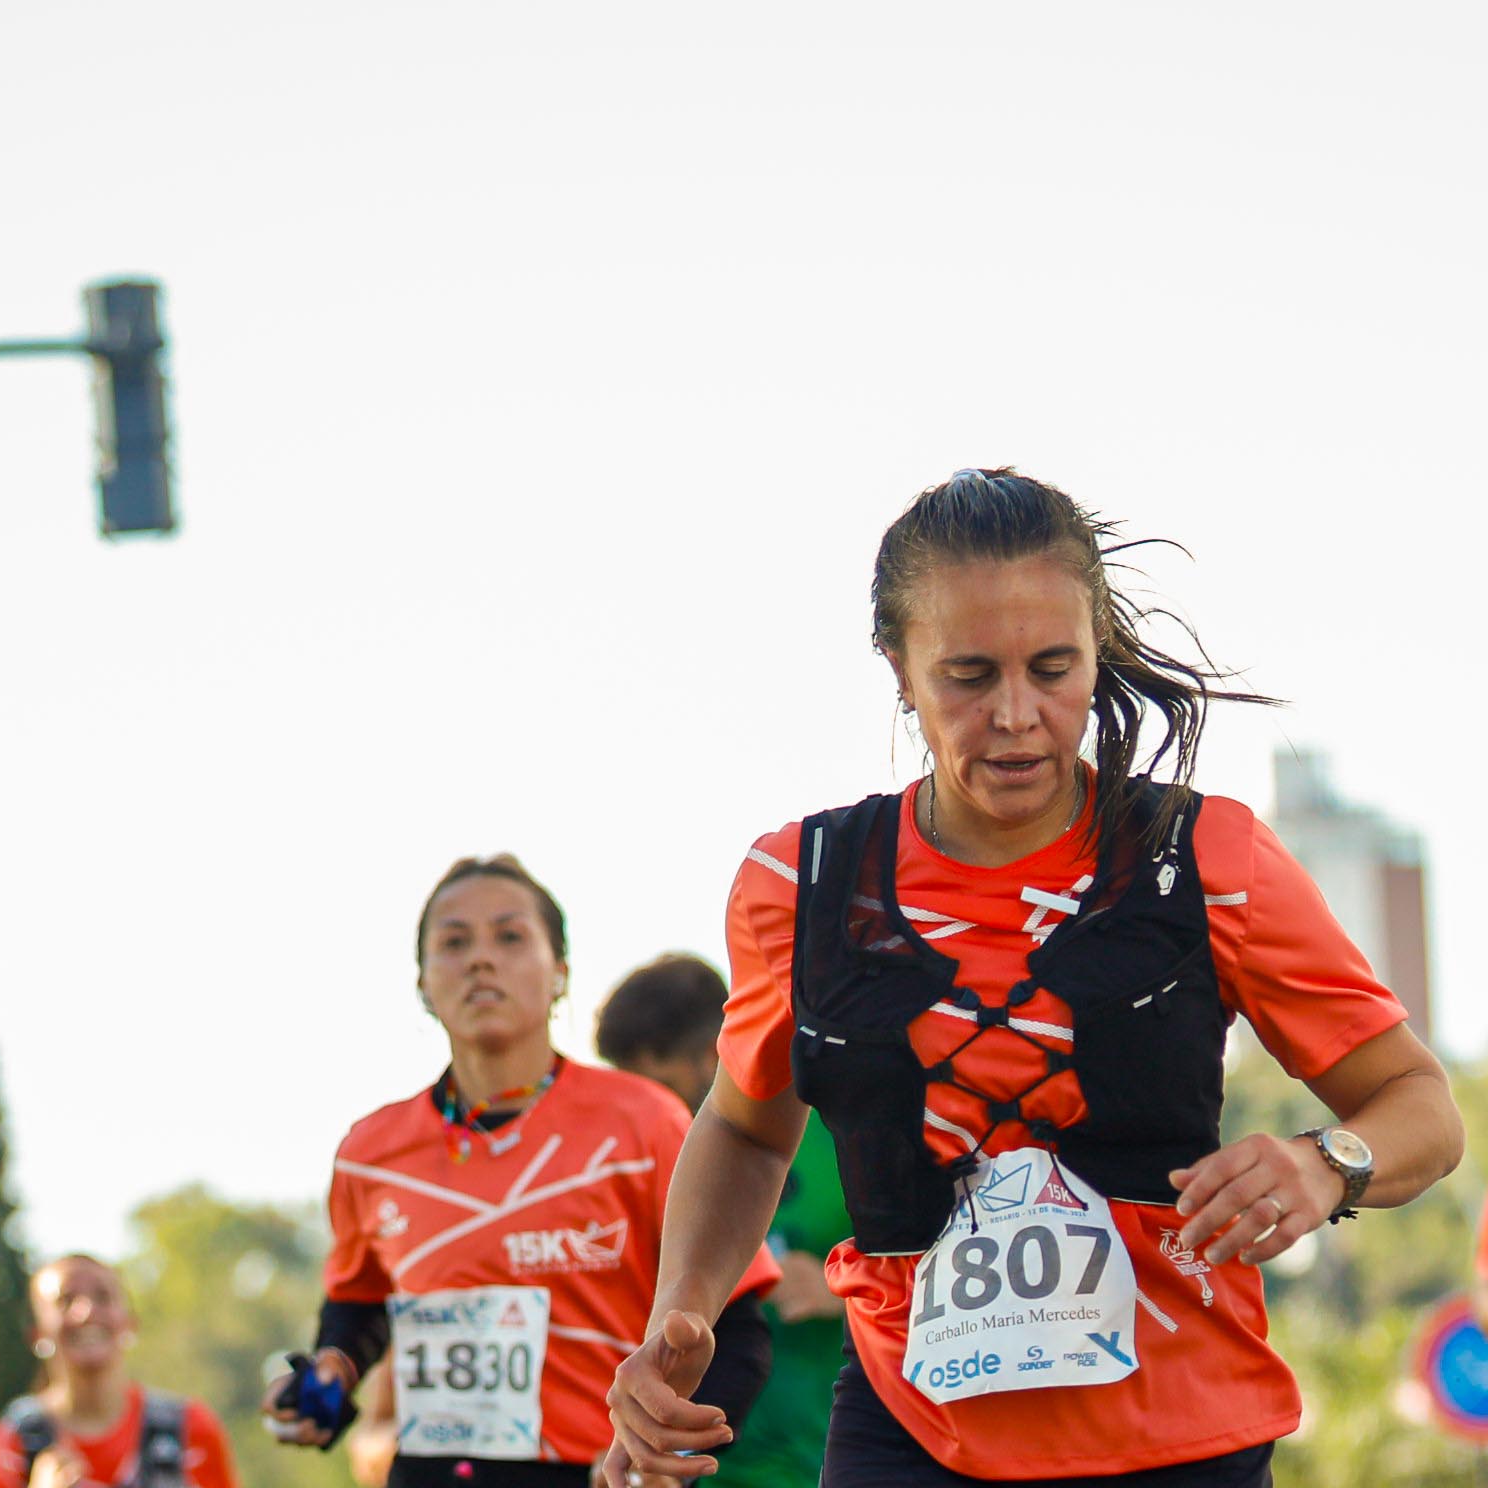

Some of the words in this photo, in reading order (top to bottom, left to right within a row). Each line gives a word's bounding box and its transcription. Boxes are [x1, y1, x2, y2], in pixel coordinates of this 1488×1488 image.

[1046, 1183, 1073, 1203] 15K
[502, 1229, 568, 1265] 15K
[913, 1224, 1112, 1328] 1807
[925, 1320, 978, 1345] Carballo
[1029, 1306, 1101, 1324] Mercedes
[405, 1342, 531, 1393] 1830
[928, 1350, 1002, 1388] osde
